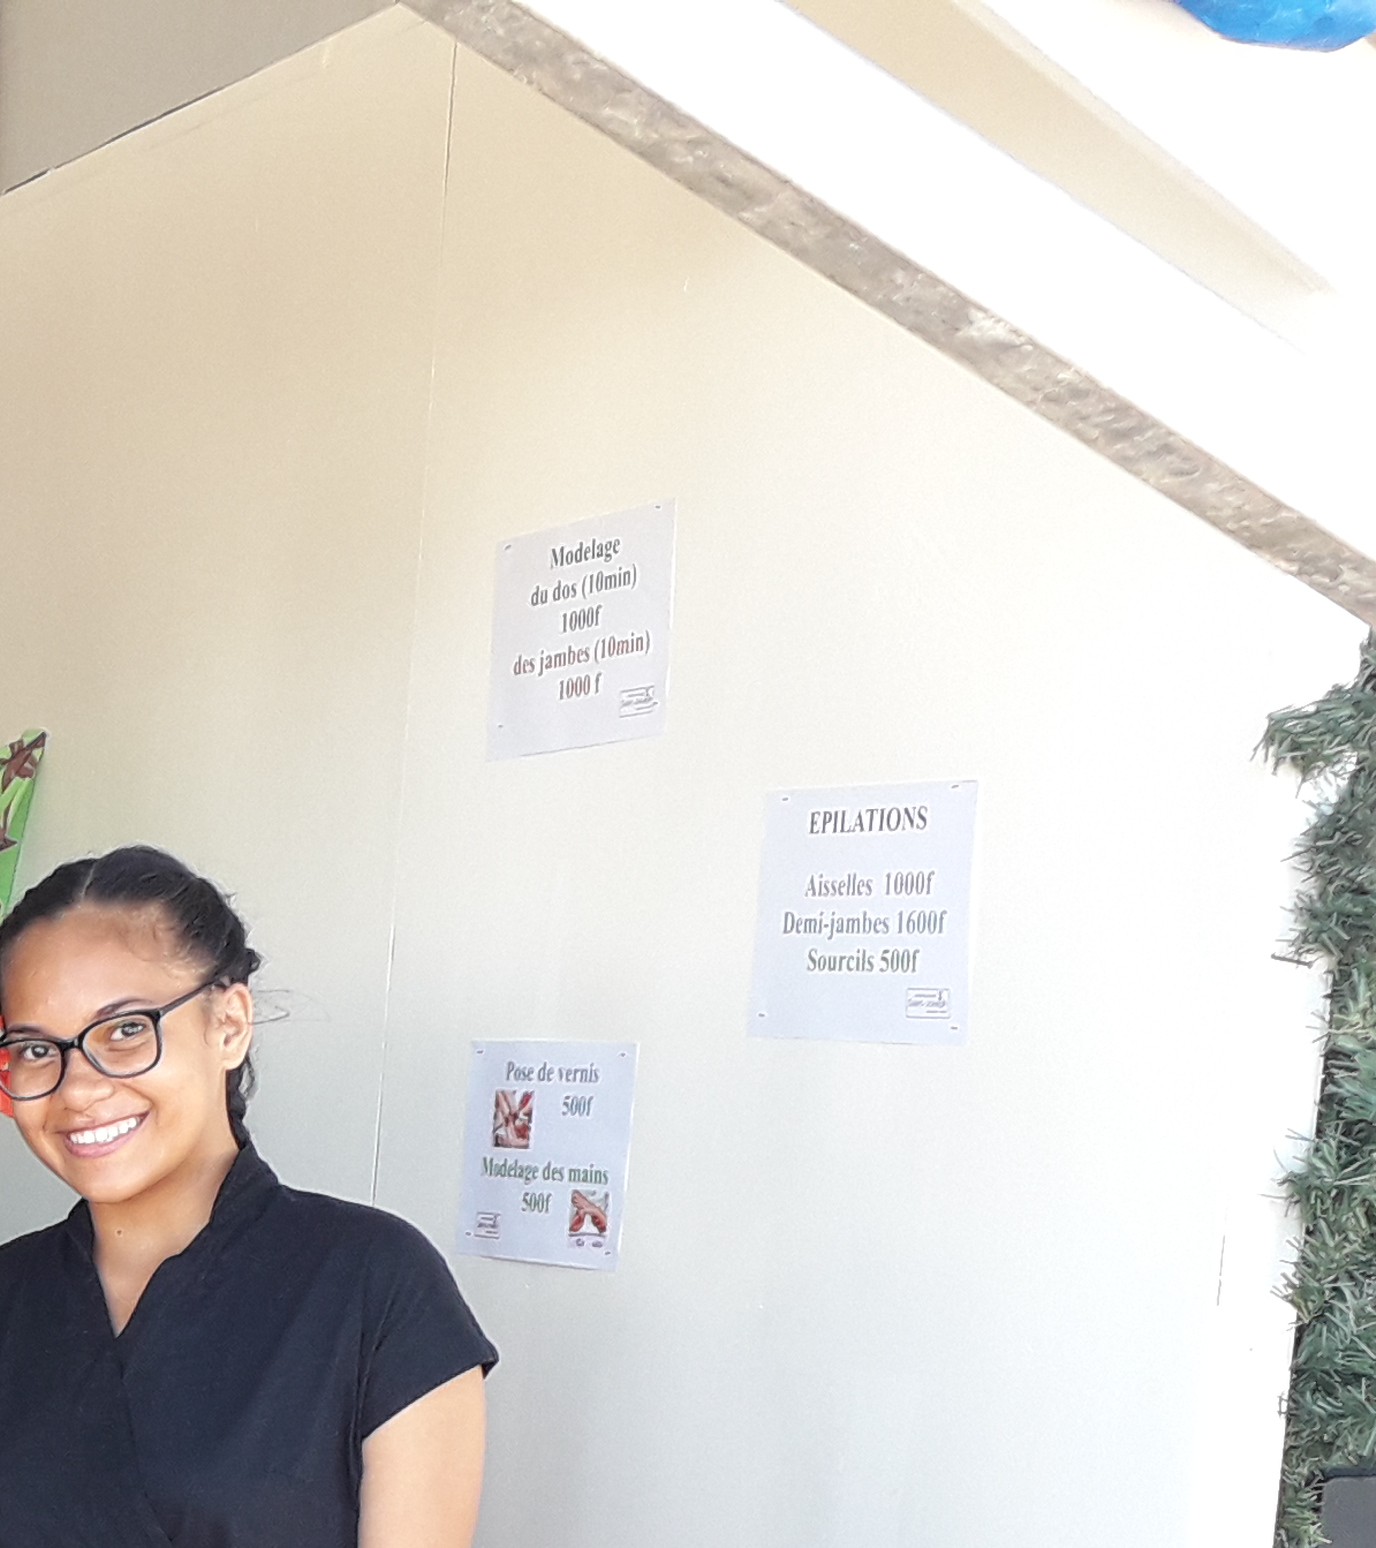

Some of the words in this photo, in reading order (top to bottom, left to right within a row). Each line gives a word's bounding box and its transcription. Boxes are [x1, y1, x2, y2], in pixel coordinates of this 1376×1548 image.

[551, 538, 621, 568] Modelage
[531, 585, 548, 606] du
[553, 580, 577, 601] dos
[582, 564, 637, 599] (10min)
[562, 605, 602, 633] 1000f
[513, 655, 535, 675] des
[538, 646, 590, 676] jambes
[594, 630, 650, 664] (10min)
[559, 675, 590, 700] 1000
[595, 673, 602, 694] f
[809, 806, 928, 834] EPILATIONS
[805, 873, 873, 897] Aisselles
[884, 871, 935, 895] 1000f
[783, 911, 890, 940] Demi-jambes
[897, 910, 947, 934] 1600f
[807, 948, 874, 972] Sourcils
[879, 949, 920, 973] 500f
[506, 1061, 534, 1081] Pose
[537, 1062, 554, 1082] de
[559, 1063, 599, 1083] vernis
[562, 1096, 594, 1116] 500f
[481, 1157, 538, 1185] Modelage
[542, 1161, 563, 1182] des
[568, 1164, 608, 1184] mains
[521, 1192, 552, 1213] 500f
